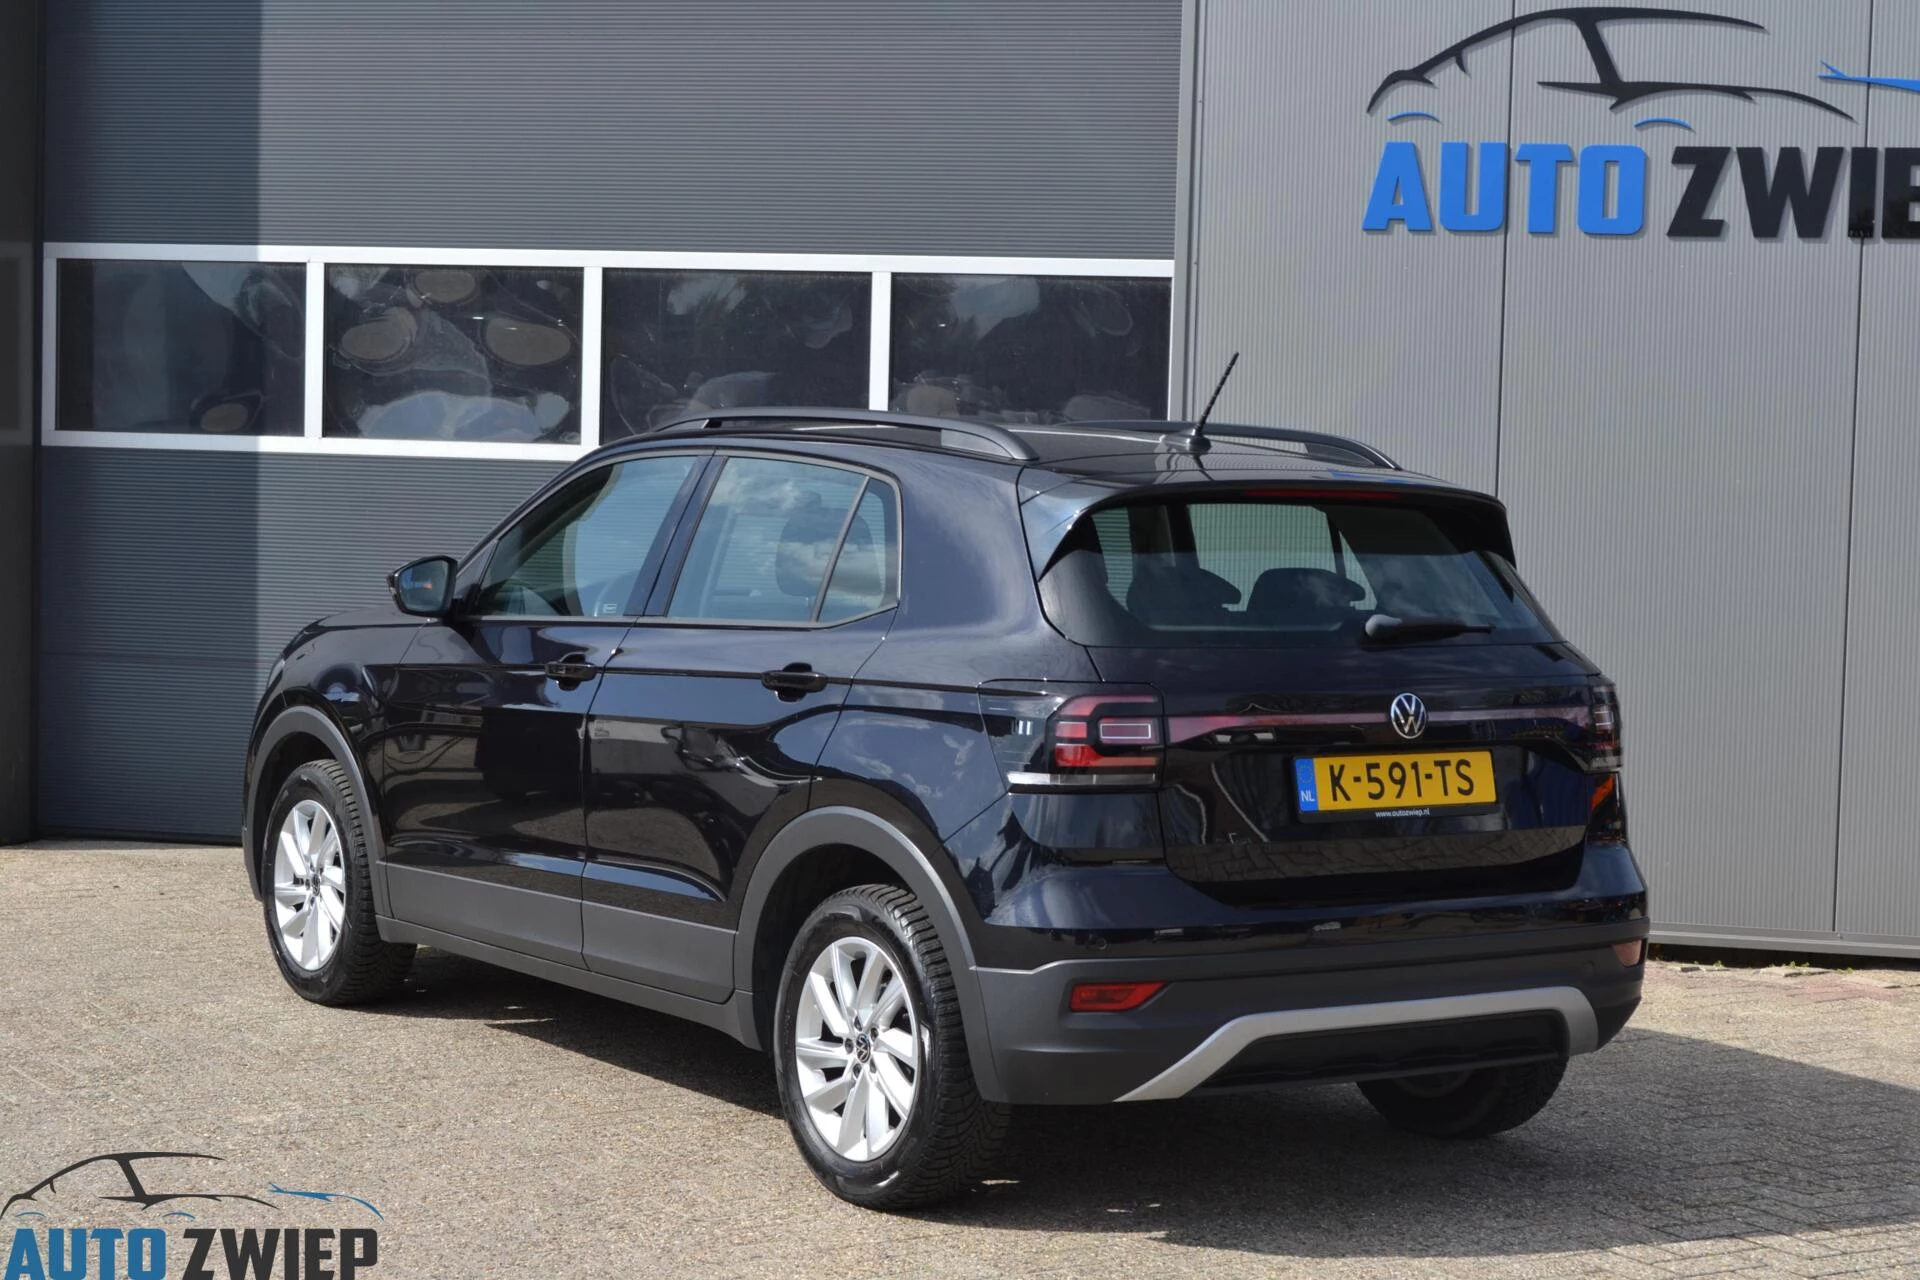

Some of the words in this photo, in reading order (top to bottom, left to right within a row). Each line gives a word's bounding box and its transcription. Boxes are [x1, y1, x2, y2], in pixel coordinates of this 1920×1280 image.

[1363, 142, 1646, 236] AUTO
[1301, 790, 1315, 802] NL
[1329, 759, 1474, 802] K-591-TS
